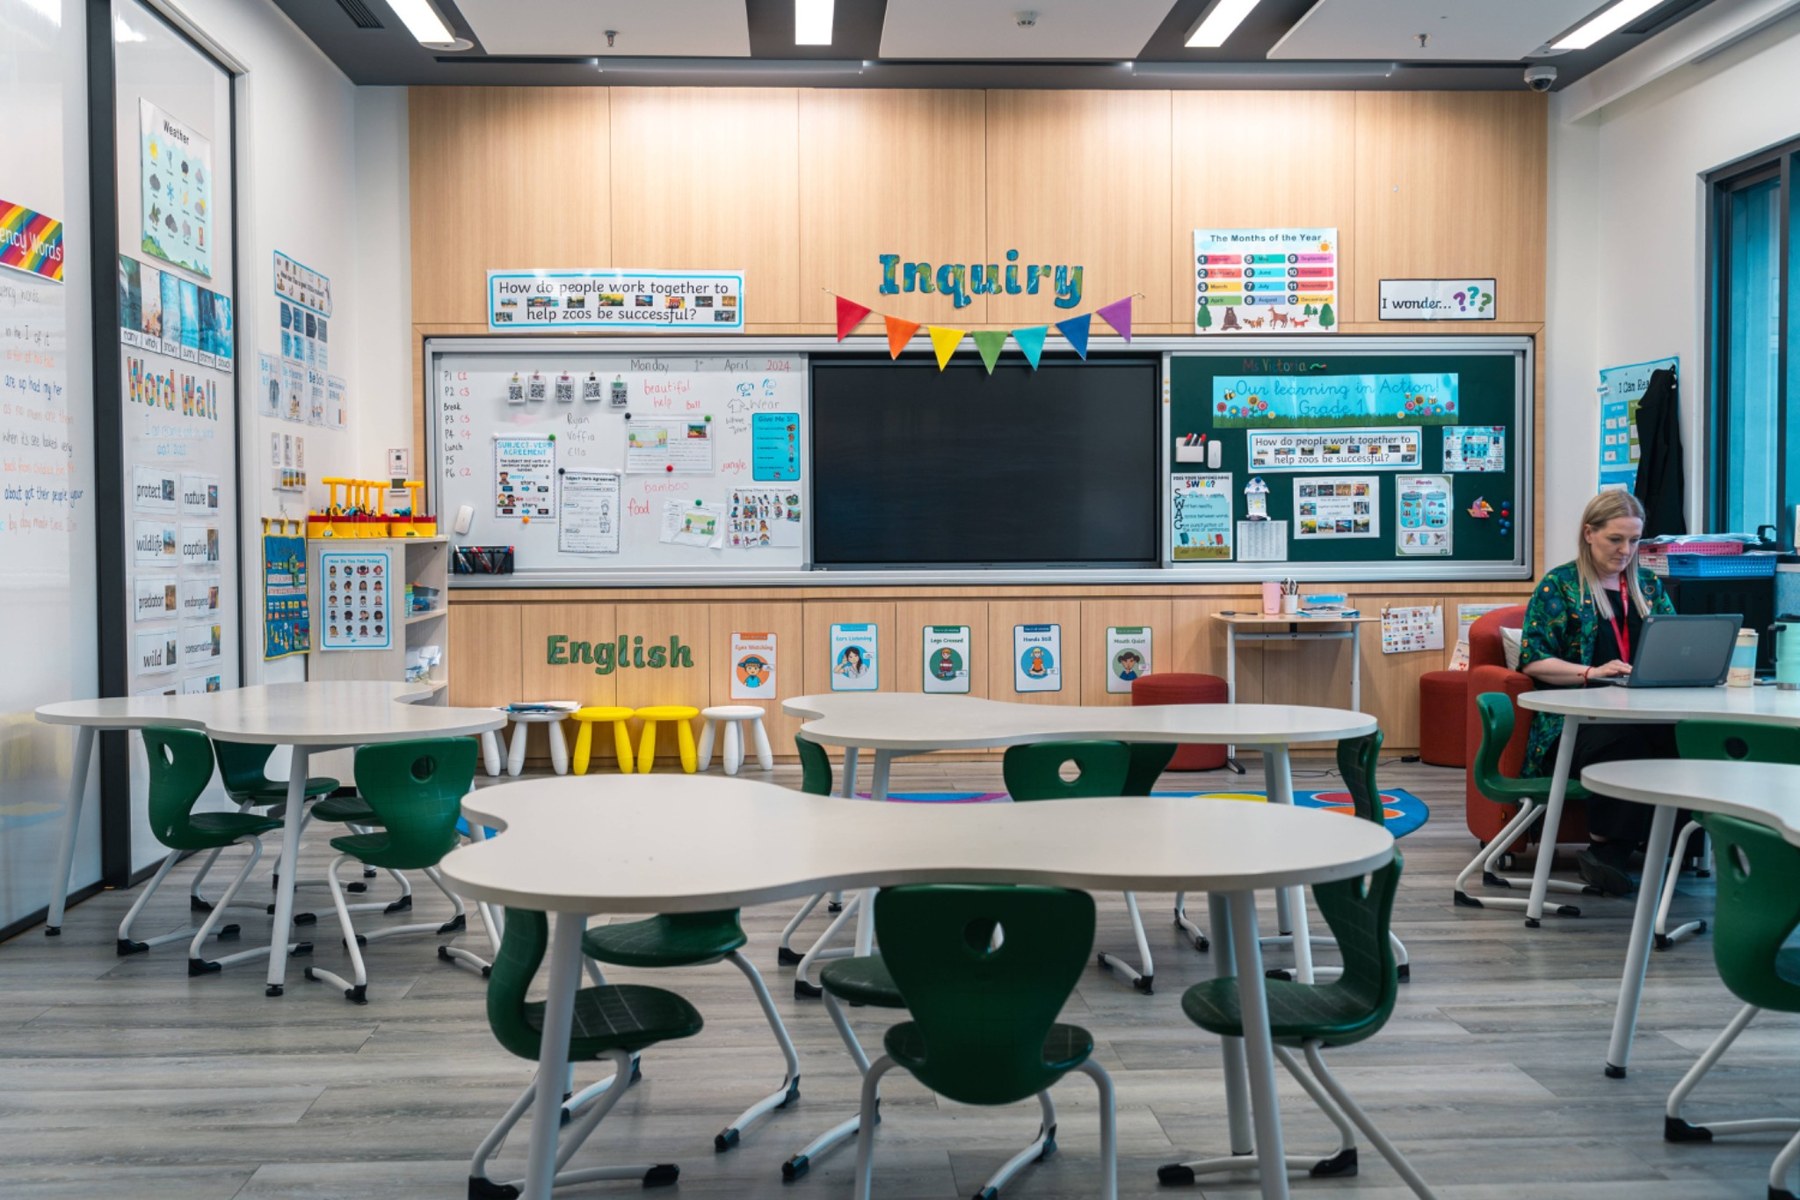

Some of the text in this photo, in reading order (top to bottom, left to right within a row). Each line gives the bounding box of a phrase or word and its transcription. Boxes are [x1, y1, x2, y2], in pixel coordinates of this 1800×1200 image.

[163, 120, 189, 145] Weather
[880, 249, 1083, 308] Inquiry
[500, 281, 728, 298] How do people work together to
[1382, 297, 1451, 309] I wonder...
[527, 307, 697, 324] help zoos be successful?
[630, 360, 669, 373] Monday
[724, 358, 749, 372] April
[766, 359, 792, 372] 2024
[128, 356, 218, 421] Word Wall
[445, 386, 454, 396] P2
[643, 379, 690, 395] beautiful
[1235, 376, 1439, 401] Our learning in Action!
[1623, 381, 1635, 393] Can
[444, 402, 461, 411] Break
[653, 397, 672, 409] help
[1299, 400, 1350, 415] Grade
[445, 415, 454, 424] P3
[567, 413, 589, 428] Ryan
[444, 442, 462, 452] Lunch
[1256, 436, 1410, 450] How do people work together to
[445, 456, 454, 465] P5
[1274, 454, 1390, 466] help zoos be successful?
[446, 468, 455, 478] P6
[644, 480, 689, 494] bamboo
[1186, 480, 1215, 488] SWAG?
[4, 483, 22, 500] about
[25, 484, 34, 506] got
[137, 484, 161, 501] protect
[184, 490, 206, 504] nature
[627, 497, 650, 516] food
[136, 534, 162, 556] wildlife
[183, 539, 207, 559] captive
[139, 593, 164, 612] predator
[143, 648, 162, 667] wild
[547, 635, 694, 674] English
